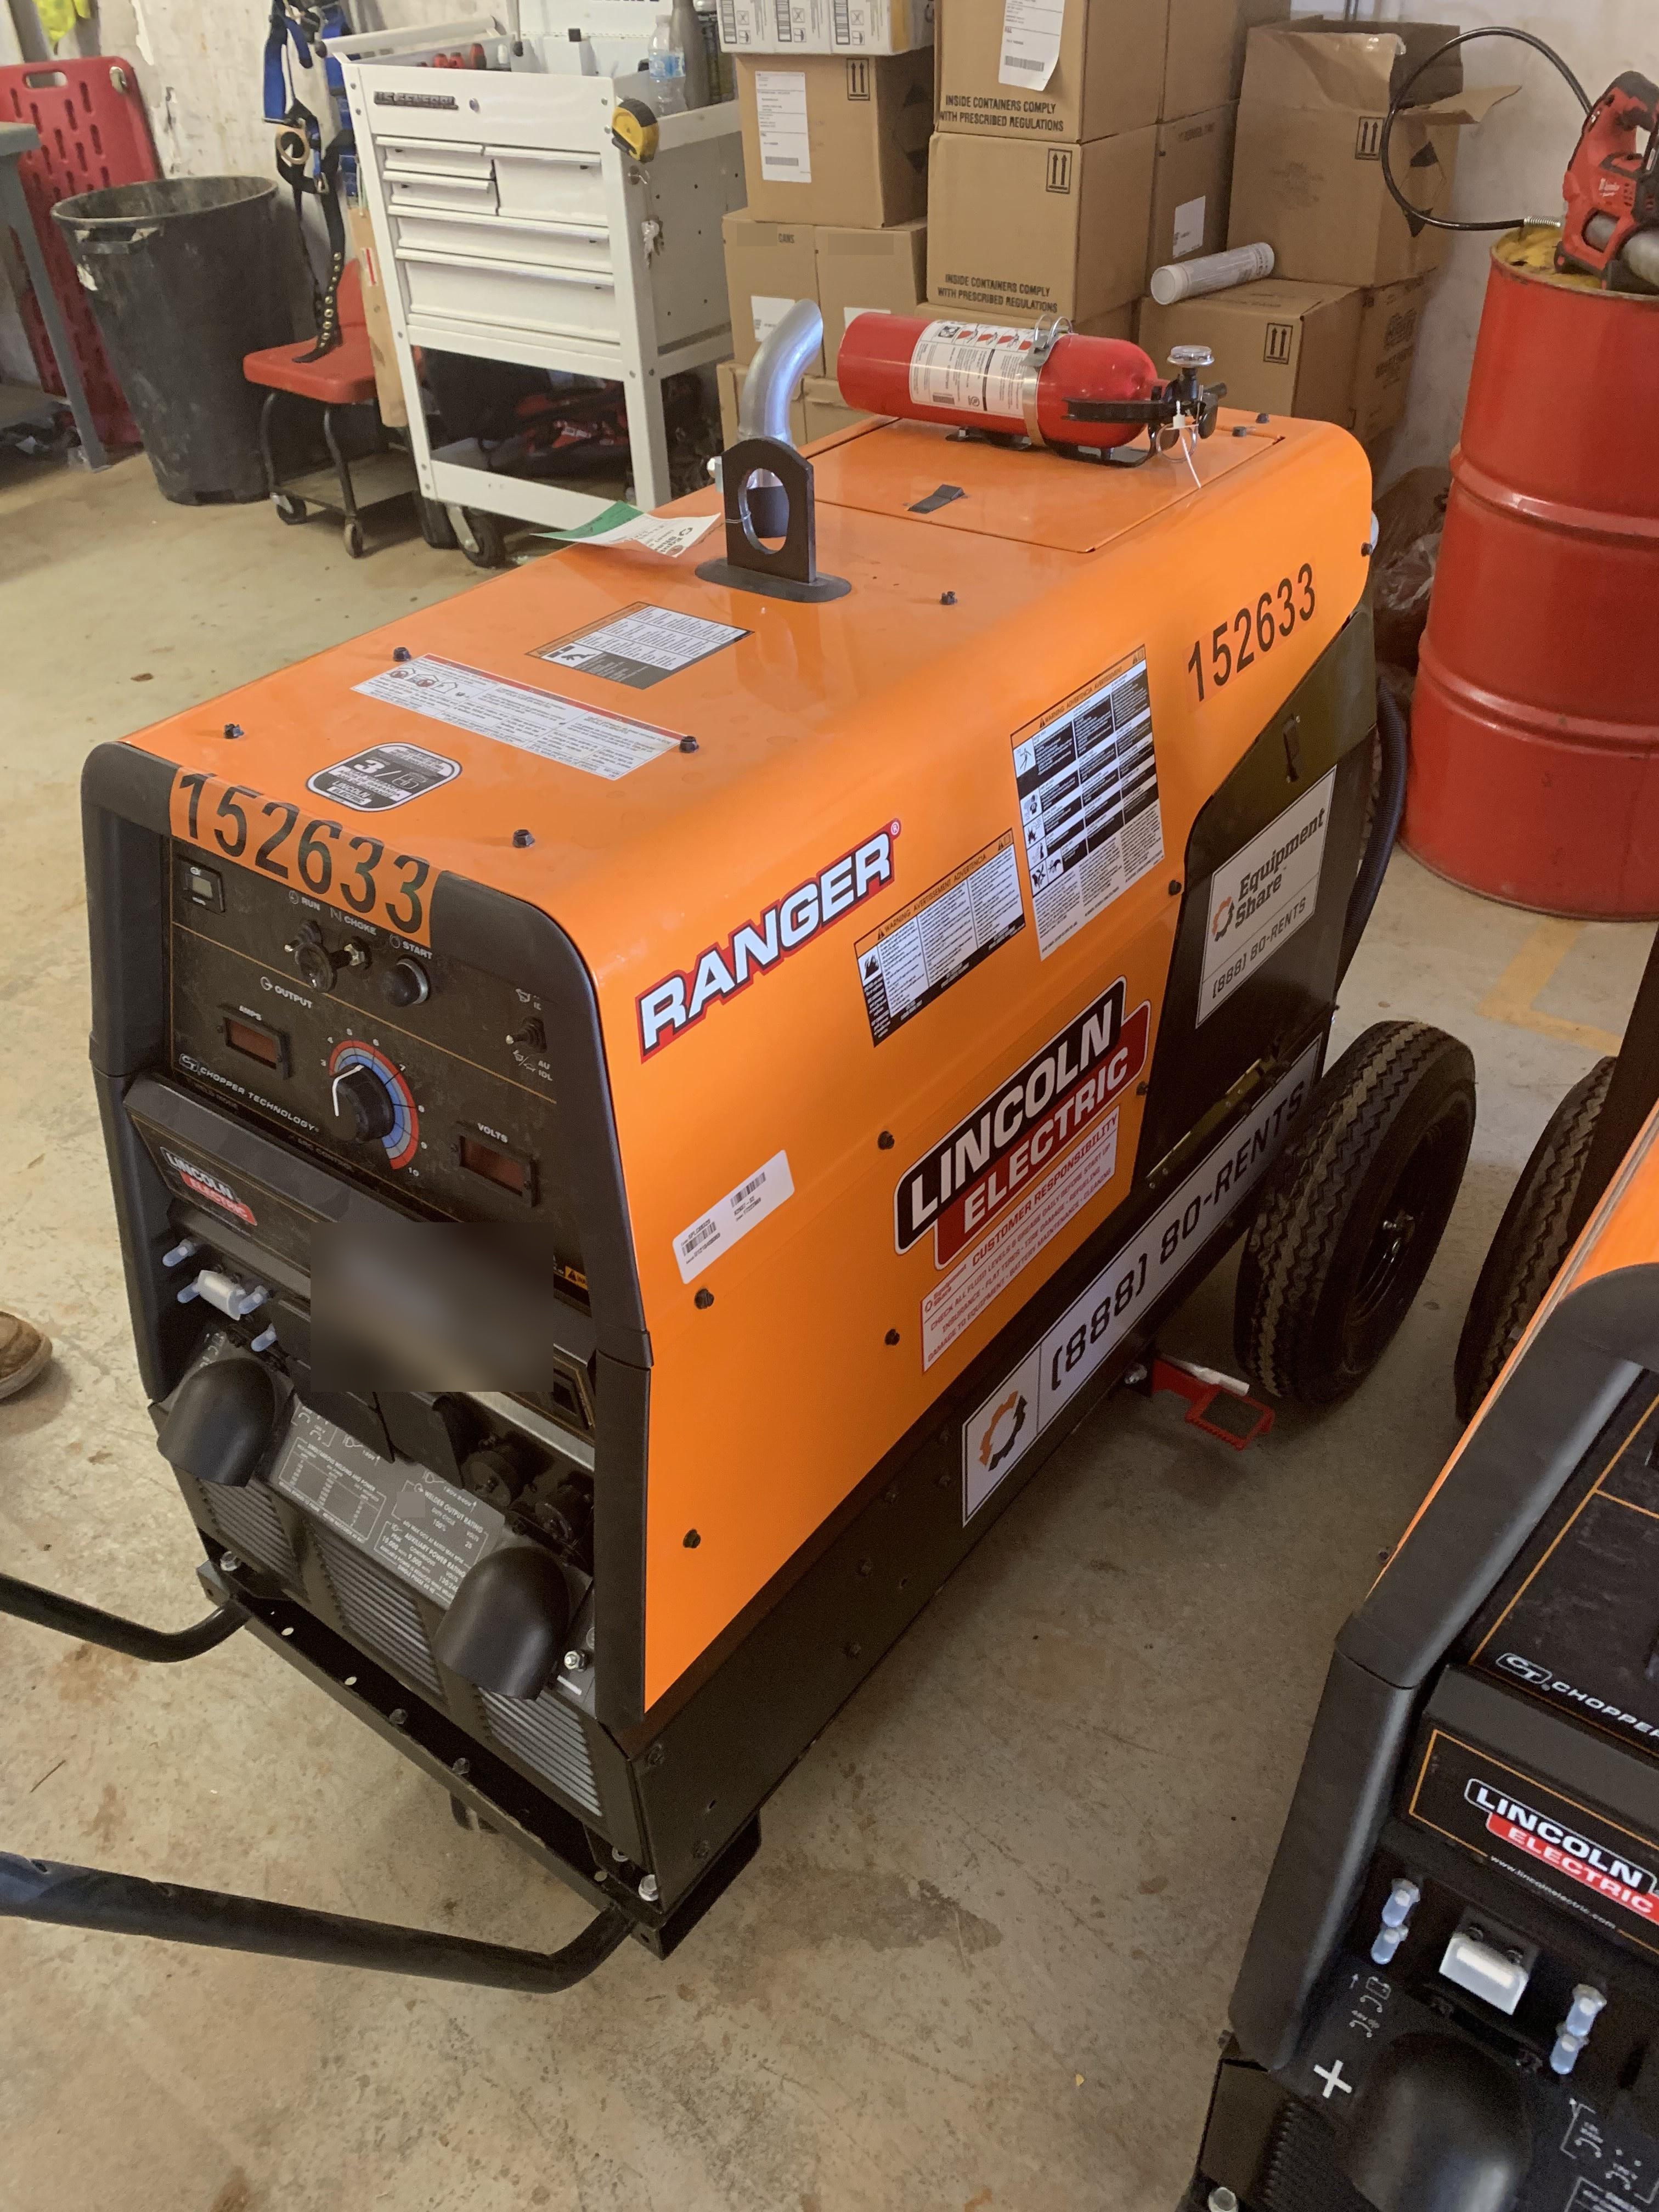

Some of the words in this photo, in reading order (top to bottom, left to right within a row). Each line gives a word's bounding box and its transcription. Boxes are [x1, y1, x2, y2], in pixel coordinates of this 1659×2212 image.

[946, 95, 971, 108] INSIDE
[973, 96, 1022, 111] CONTAINERS
[1023, 100, 1056, 114] COMPLY
[960, 111, 1007, 127] PRESCRIBED
[1009, 116, 1064, 132] REGULATIONS
[938, 286, 957, 299] WITH
[958, 289, 1003, 305] PRESCRIBED
[1006, 296, 1058, 313] REGULATIONS
[945, 274, 969, 286] INSIDE
[970, 276, 1017, 292] CONTAINERS
[1019, 283, 1051, 297] COMPLY
[1188, 563, 1315, 702] 152633
[332, 780, 371, 798] LINCOLN
[332, 788, 366, 804] ELECTRIC
[179, 772, 430, 934] 152633
[1238, 808, 1325, 901] Equipment
[301, 896, 321, 911] RUN
[884, 909, 911, 933] WARNING
[953, 853, 987, 884] ADVERTENCIA
[1235, 873, 1283, 929] Share
[343, 915, 377, 935] CHOKE
[1212, 953, 1247, 998] (888)
[1250, 896, 1307, 963] 80-RENTS
[403, 941, 433, 960] START
[239, 1005, 262, 1021] AMPS
[275, 985, 313, 1008] OUTPUT
[200, 1066, 245, 1094] CHOPPER
[248, 1092, 315, 1131] TECHNOLOGY
[912, 998, 1113, 1231] LINCOLN
[477, 1123, 509, 1143] VOLTS
[964, 1046, 1128, 1234] ELECTRIC
[166, 1152, 234, 1200] LINCOLN
[408, 1167, 420, 1177] 10
[973, 1198, 1031, 1267] CUSTOMER
[1034, 1113, 1116, 1206] RESPONSIBILITY
[930, 1302, 953, 1332] CHECK
[955, 1289, 966, 1307] ALL
[968, 1268, 986, 1294] FLUID
[988, 1244, 1010, 1273] LEVELS
[1042, 1194, 1059, 1218] DAILY
[1084, 1151, 1101, 1176] START
[1102, 1142, 1110, 1157] UP
[1051, 1255, 1146, 1390] (888)
[1159, 1082, 1305, 1266] 80-RENTS
[928, 1327, 956, 1363] DAMAGE
[958, 1317, 966, 1332] TO
[967, 1277, 1005, 1322] EQUIPMENT
[1009, 1244, 1036, 1278] BATTERY
[1037, 1200, 1079, 1249] MAINTENANCE
[942, 1289, 980, 1334] INSURANCE
[985, 1268, 1000, 1290] FLAT
[1040, 1202, 1064, 1234] DAMAGE
[425, 1490, 445, 1507] WELDER
[444, 1504, 465, 1520] OUTPUT
[464, 1517, 483, 1533] RATING
[433, 1519, 446, 1531] 100%
[428, 1549, 448, 1565] POWER
[447, 1561, 466, 1578] RATING
[1476, 1787, 1643, 1888] LINCOLN
[1508, 1827, 1654, 1913] ELECTRIC
